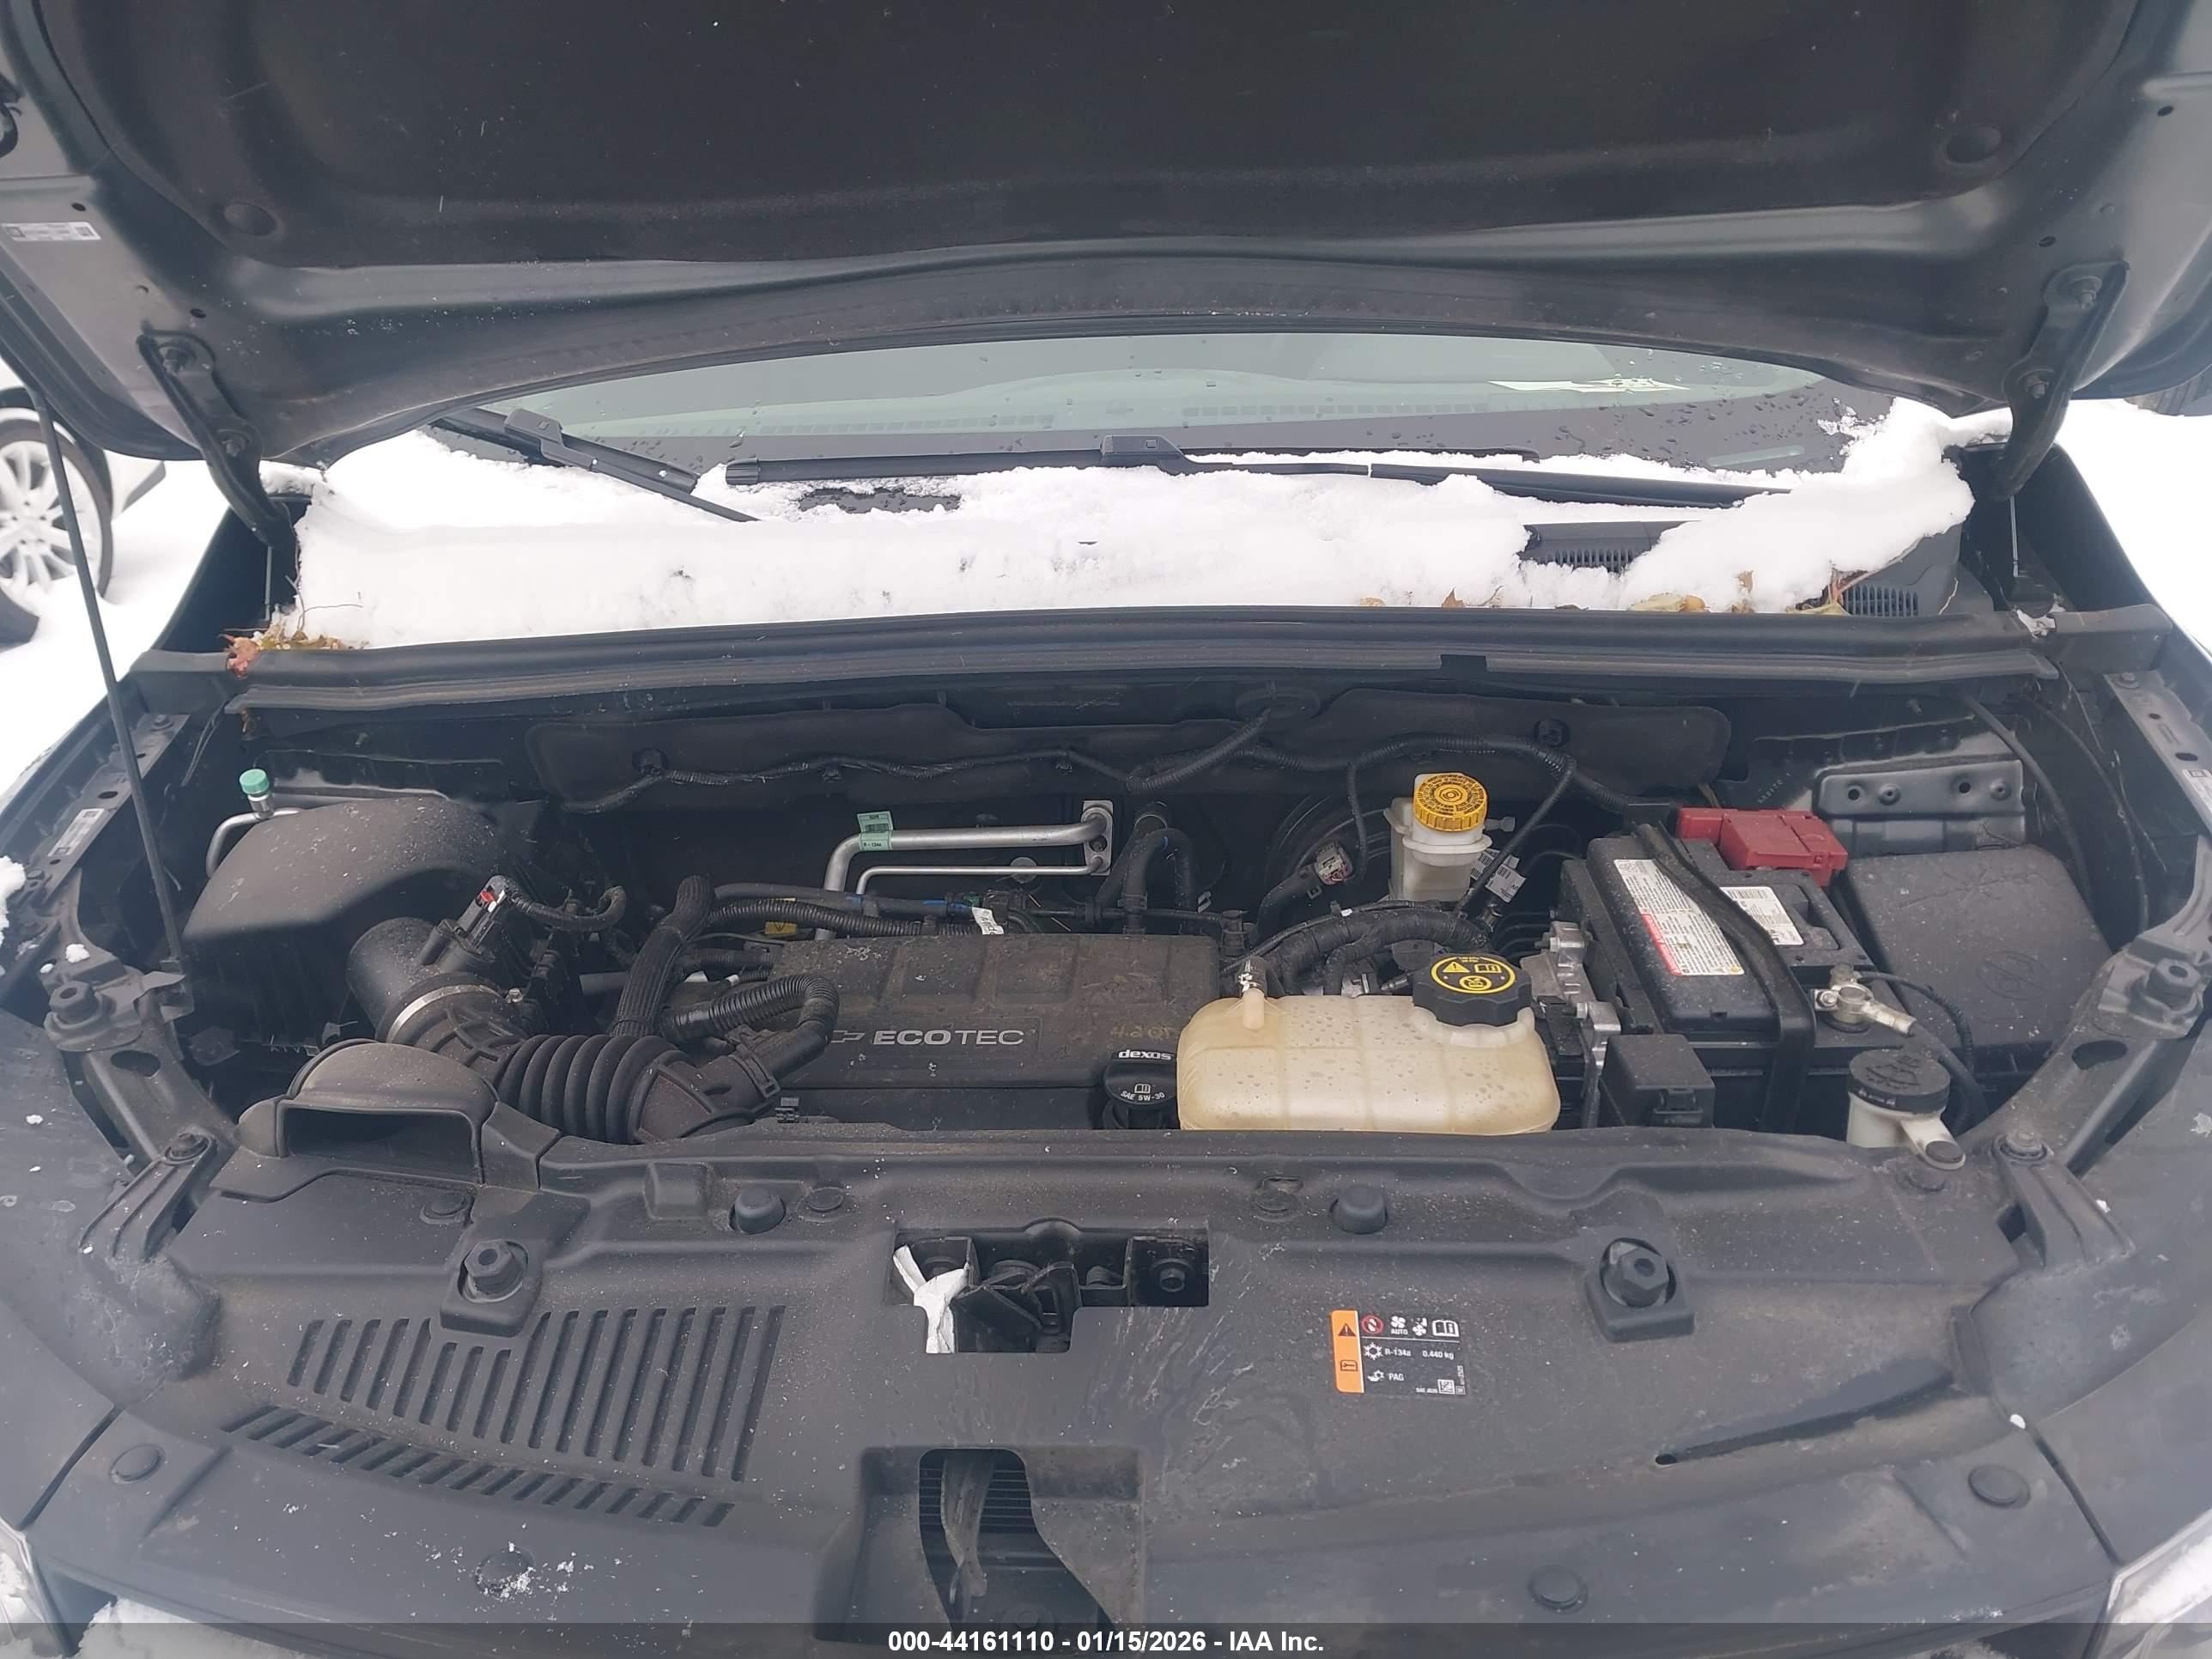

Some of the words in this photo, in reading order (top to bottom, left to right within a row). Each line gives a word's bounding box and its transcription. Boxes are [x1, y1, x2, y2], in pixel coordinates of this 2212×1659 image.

[872, 1030, 1024, 1045] ECOTEC
[1118, 1049, 1172, 1060] dexos
[1121, 1091, 1135, 1100] SAE
[1138, 1091, 1165, 1102] 5W-30
[1384, 1348, 1412, 1357] R-134a
[1422, 1350, 1443, 1358] 0.440
[1444, 1352, 1454, 1360] kg
[1389, 1373, 1404, 1382] PAG
